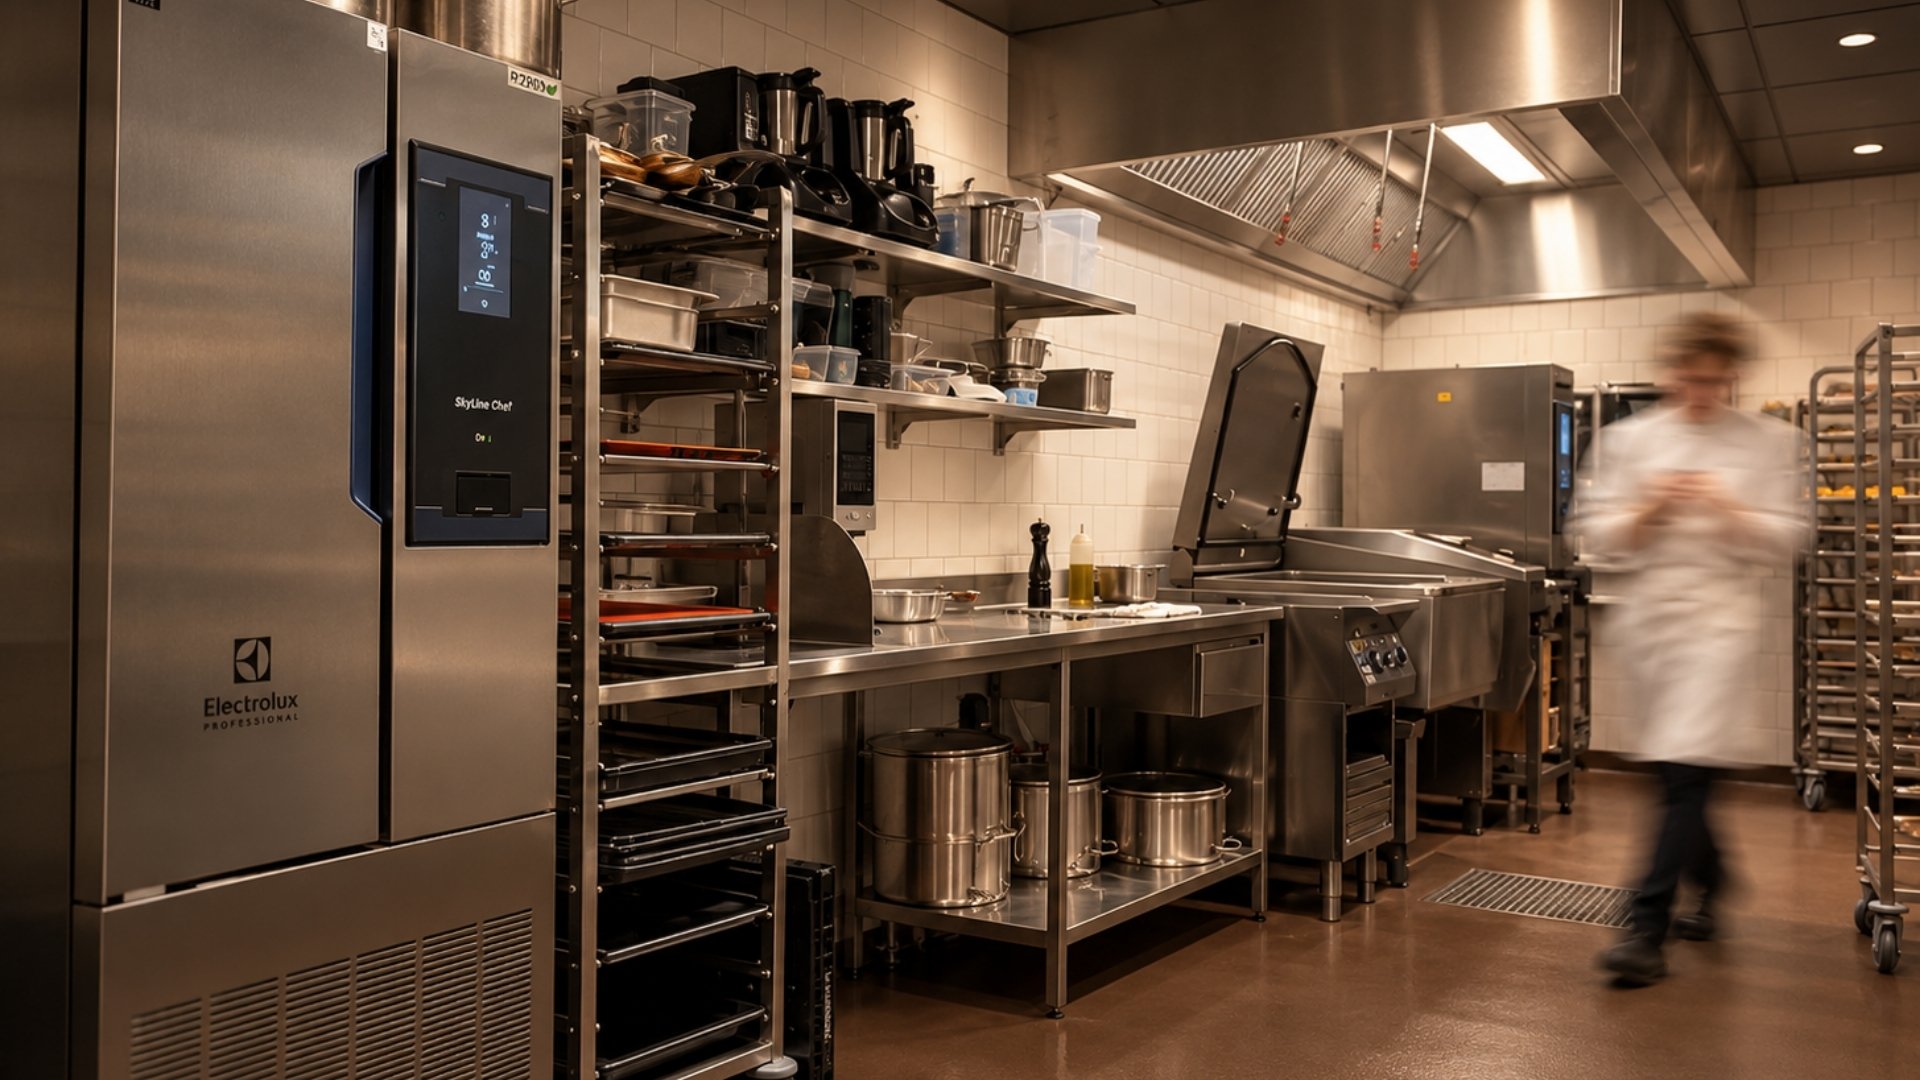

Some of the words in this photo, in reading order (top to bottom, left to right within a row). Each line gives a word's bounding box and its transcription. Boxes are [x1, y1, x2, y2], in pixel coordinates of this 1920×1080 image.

[454, 396, 490, 411] SkyLine
[491, 399, 513, 412] Chef
[204, 691, 299, 718] Electrolux
[203, 712, 299, 731] PROFESSIONAL
